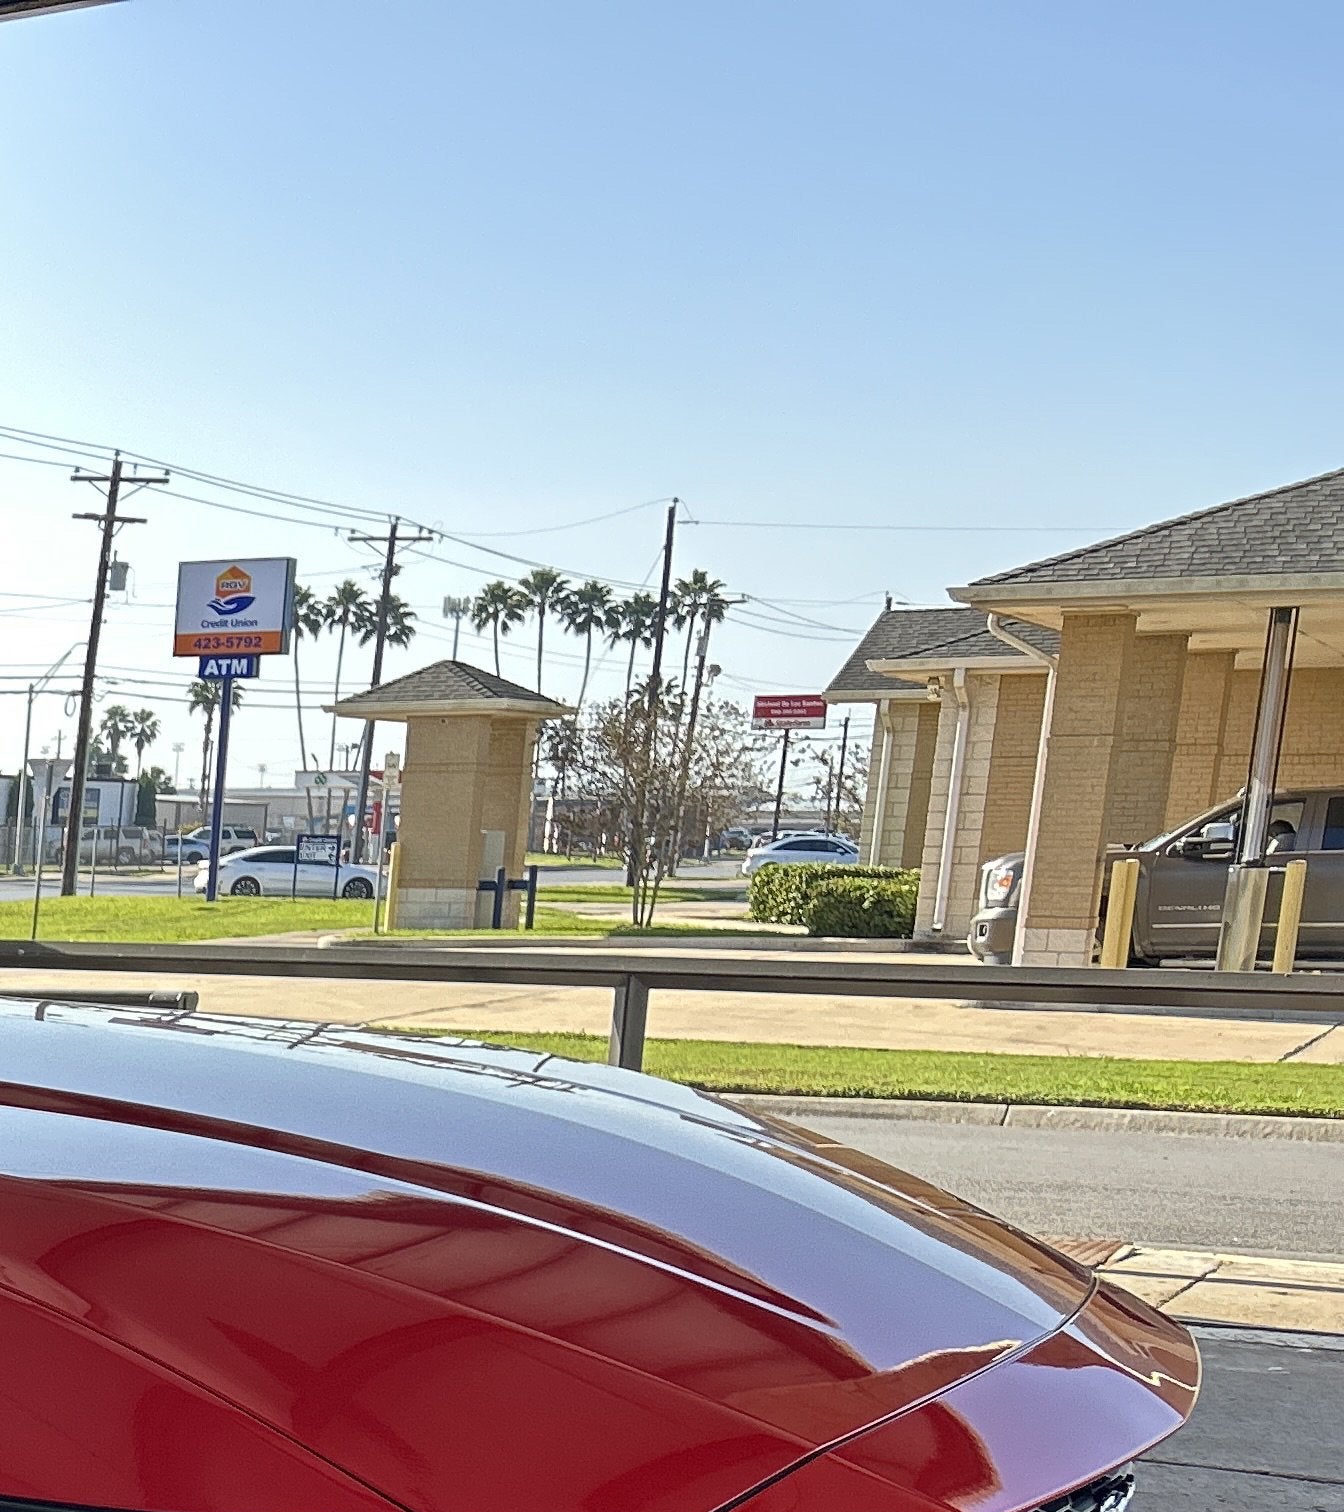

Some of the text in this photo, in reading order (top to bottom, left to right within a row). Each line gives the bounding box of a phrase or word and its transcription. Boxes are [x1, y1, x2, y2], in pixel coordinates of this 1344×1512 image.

[201, 619, 258, 629] Credit Union
[194, 636, 263, 650] 423-5792
[204, 658, 248, 676] ATM
